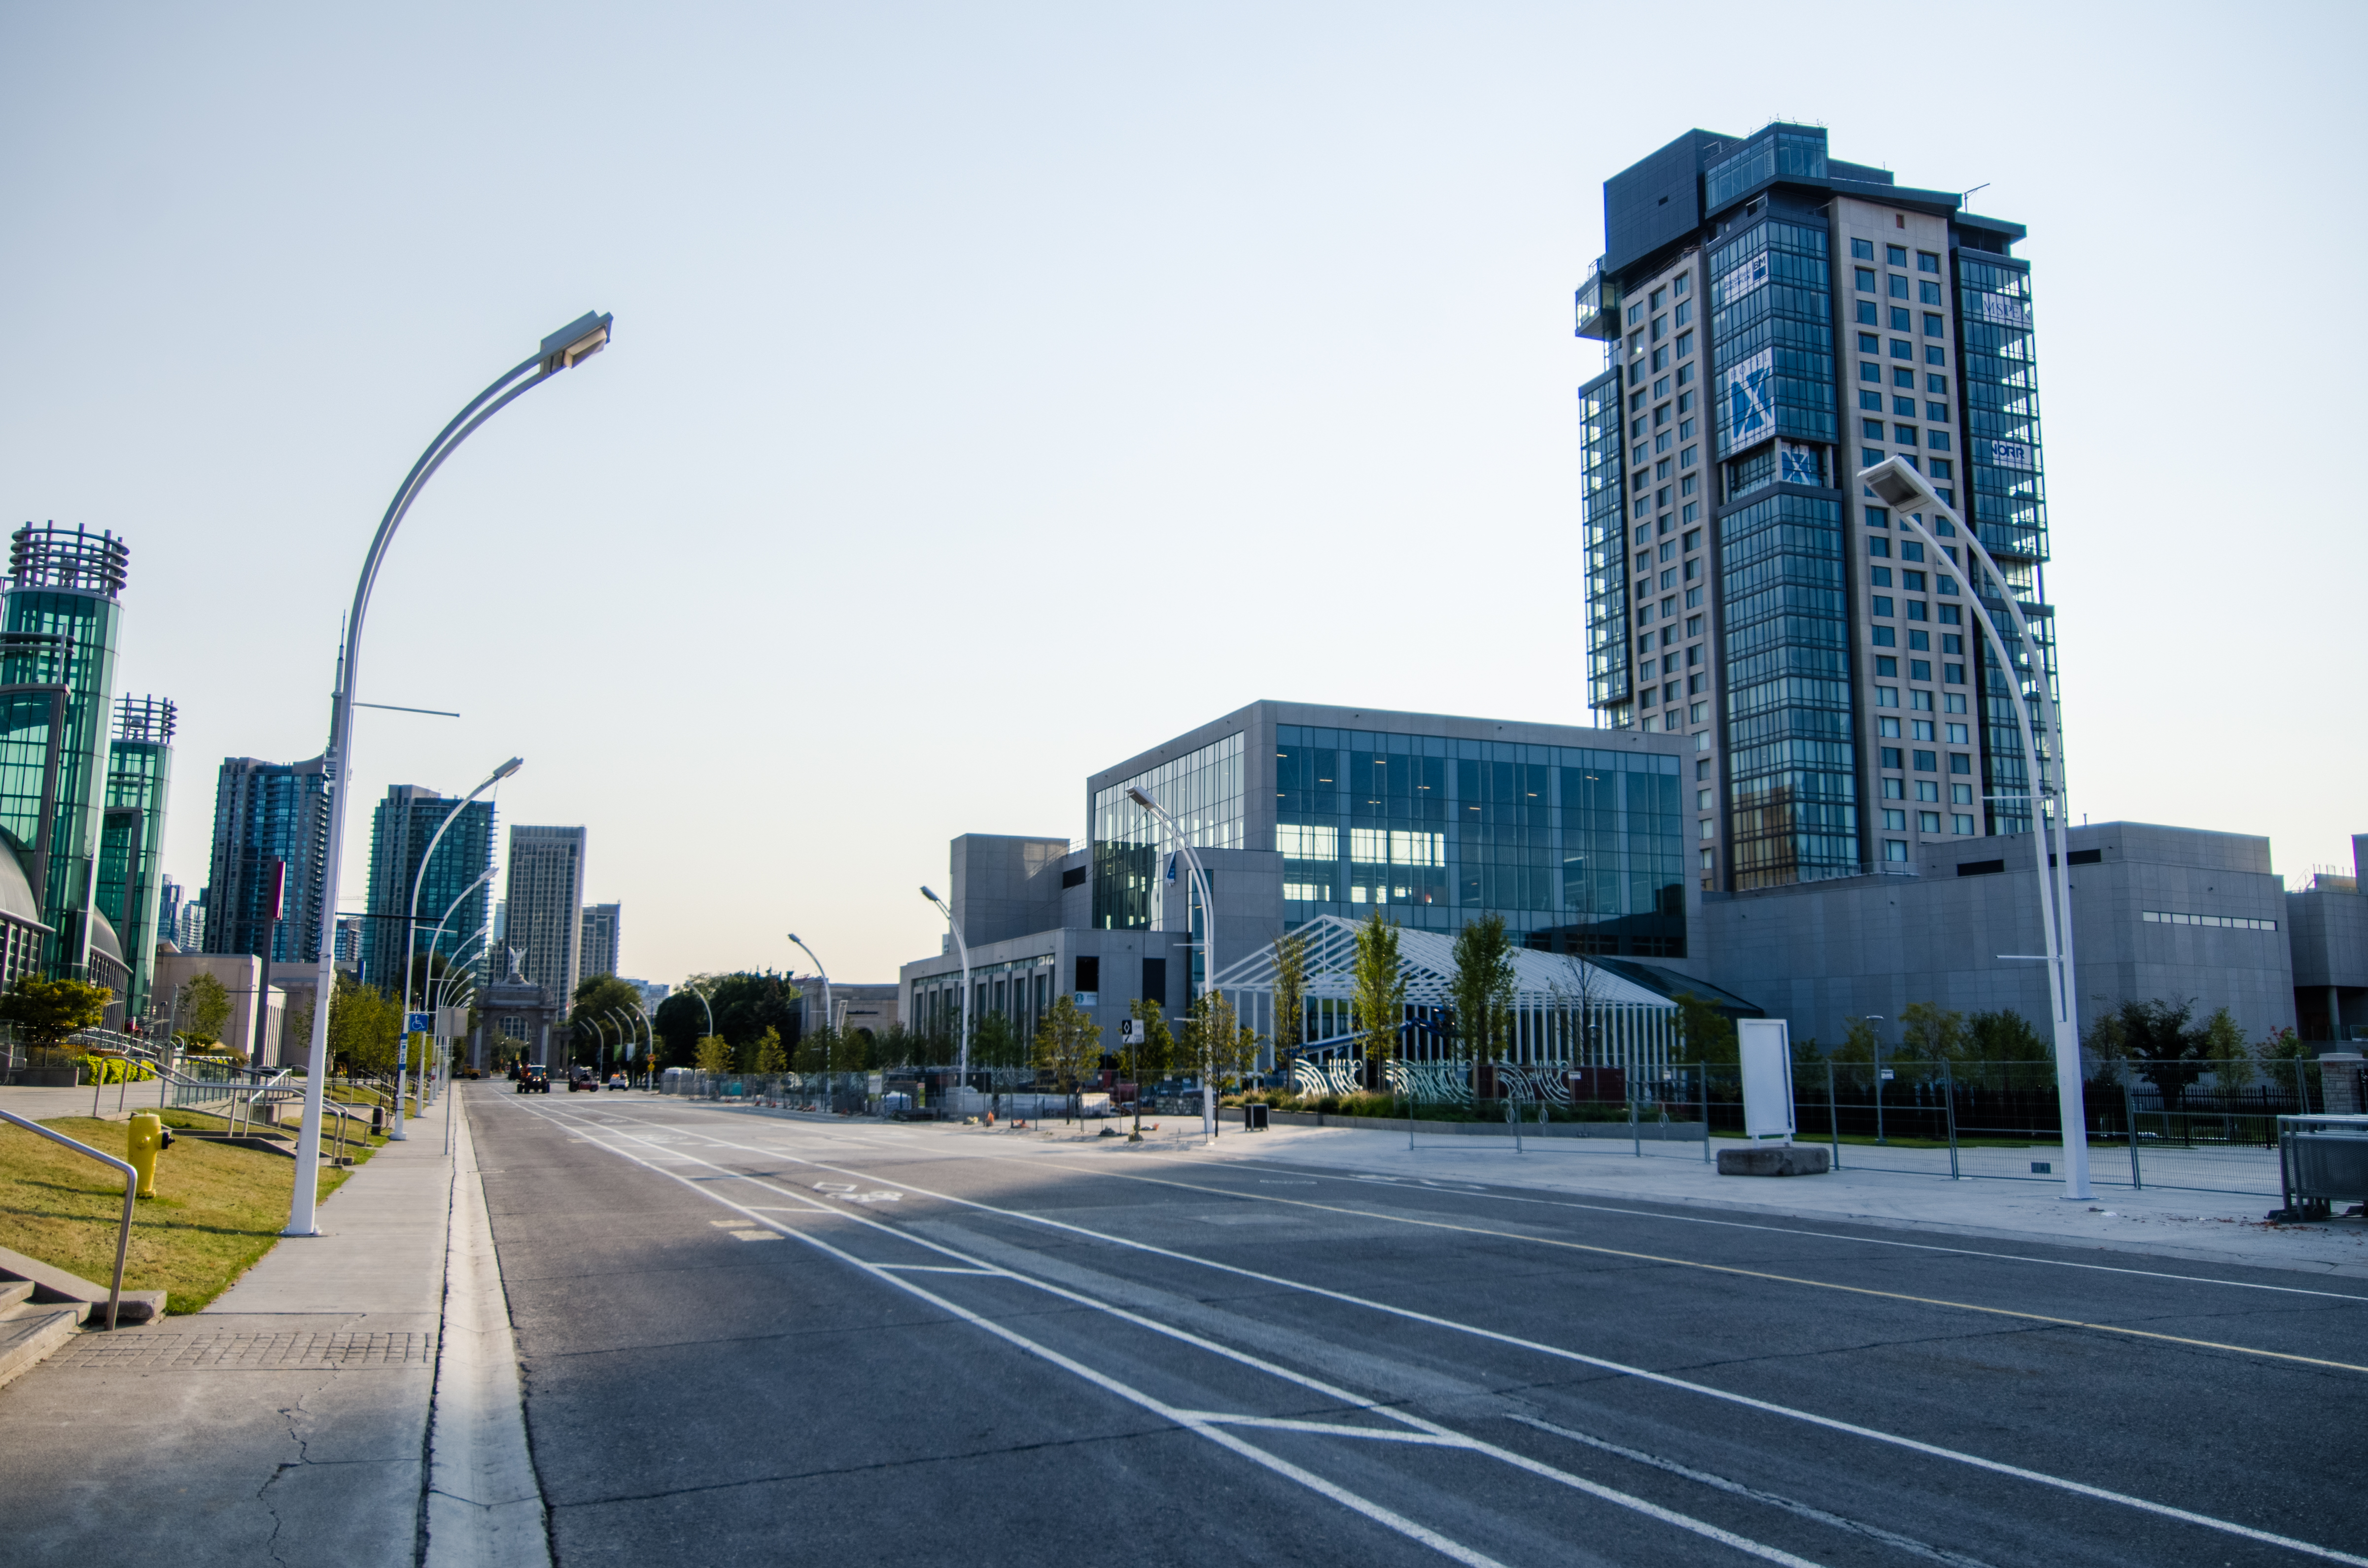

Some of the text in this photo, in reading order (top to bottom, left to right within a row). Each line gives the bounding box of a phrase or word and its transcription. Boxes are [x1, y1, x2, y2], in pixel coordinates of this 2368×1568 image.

[1753, 256, 1766, 270] BM
[1725, 267, 1751, 287] Brookfield
[1731, 353, 1769, 380] HOTEL
[1992, 443, 2025, 459] NORR
